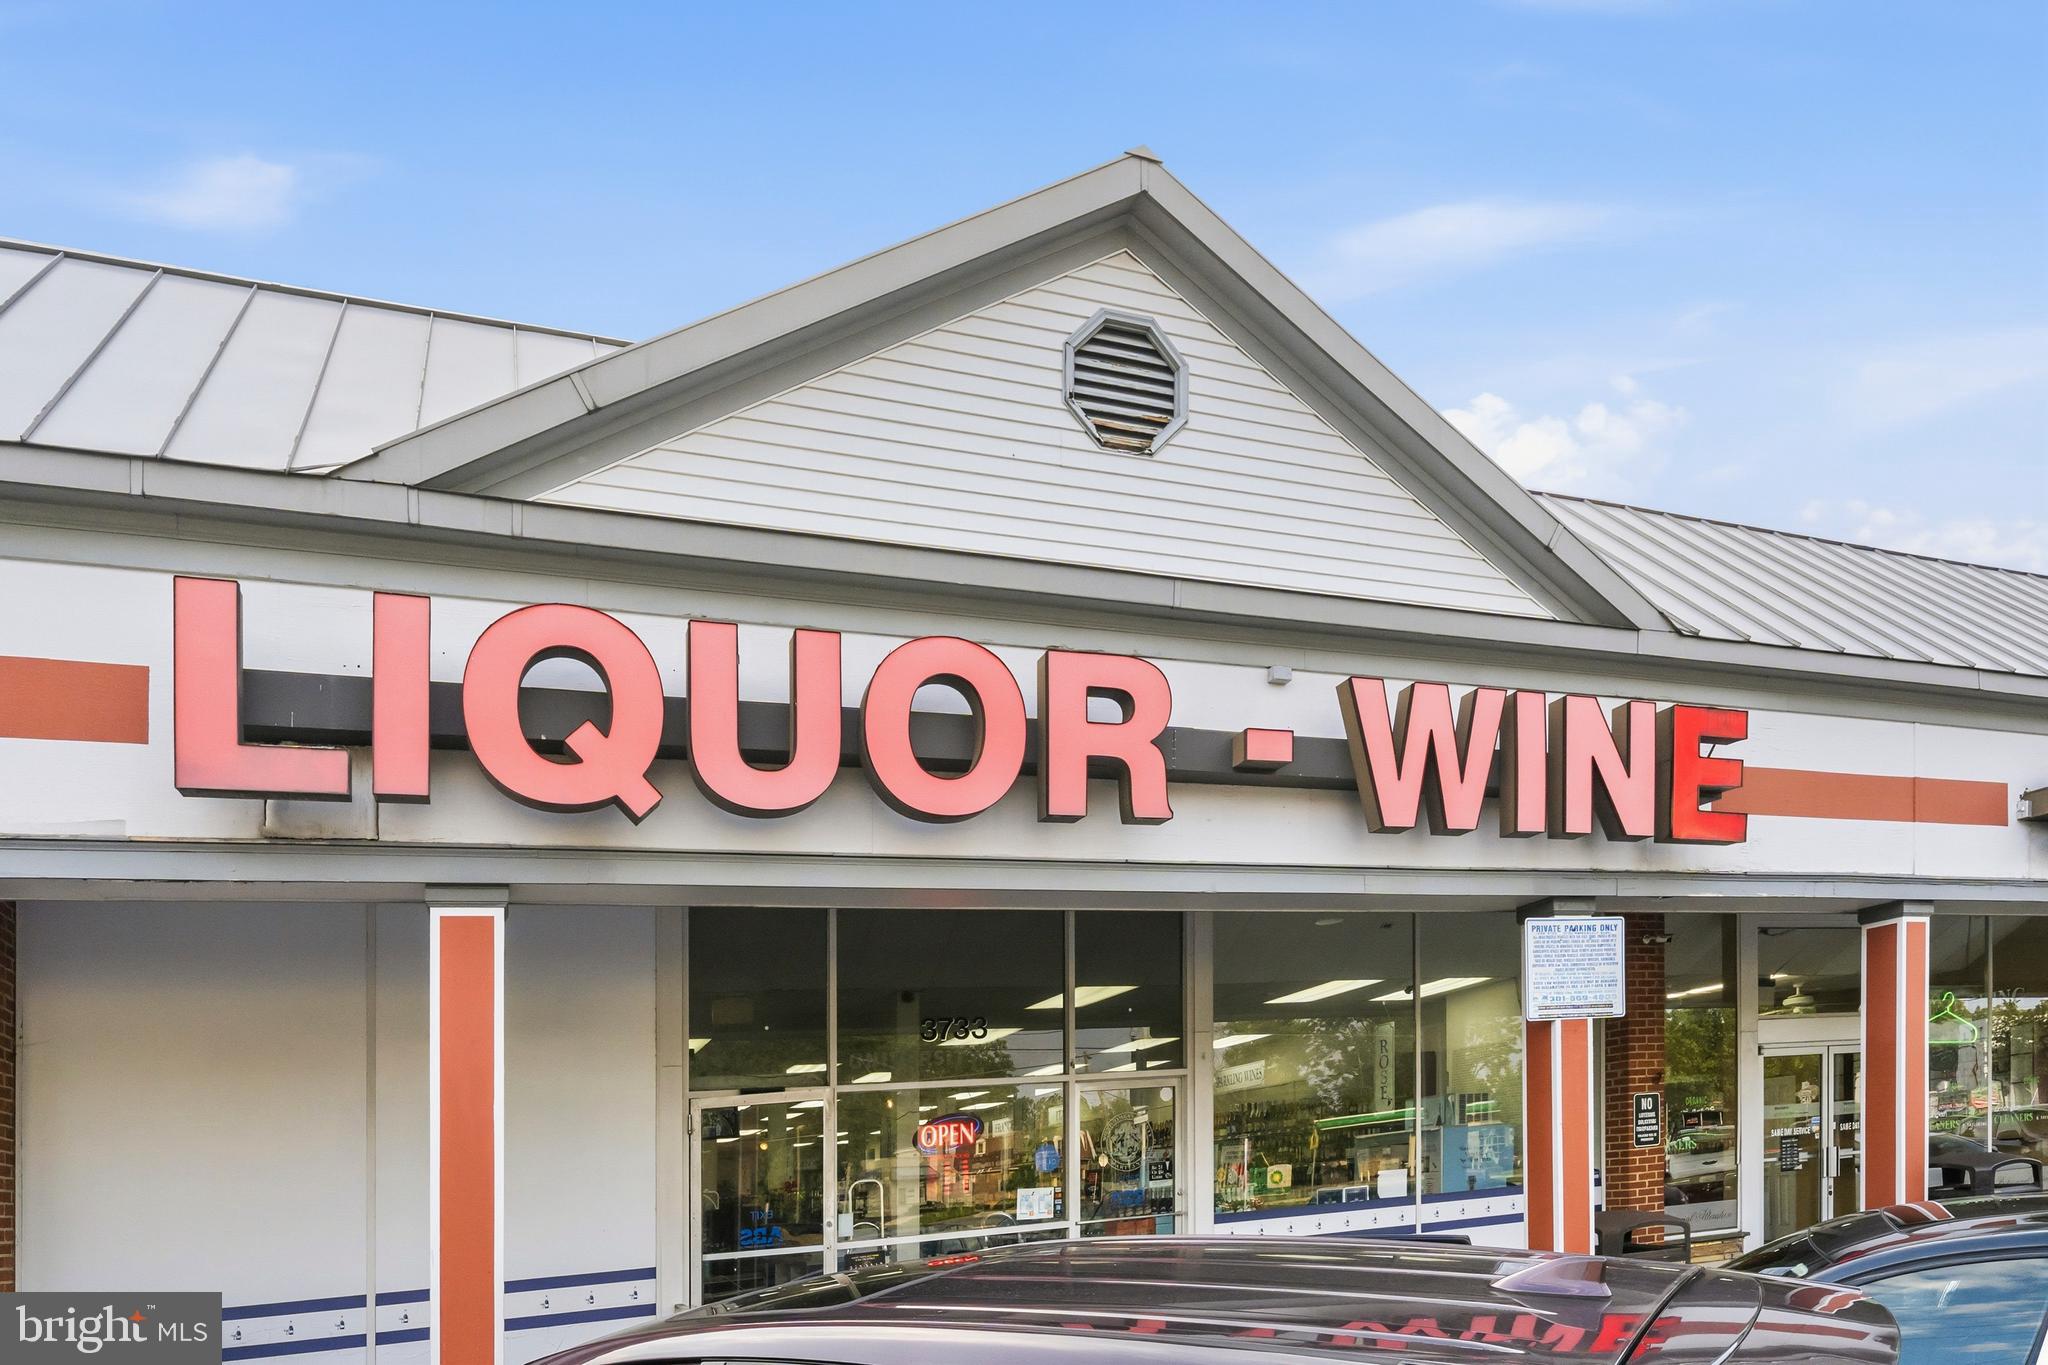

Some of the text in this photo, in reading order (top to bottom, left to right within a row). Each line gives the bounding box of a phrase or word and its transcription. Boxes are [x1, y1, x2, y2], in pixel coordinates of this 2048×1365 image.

[173, 575, 1174, 825] LIQUOR
[1336, 676, 1748, 845] WINE
[1531, 923, 1618, 933] PRIVATE PARKING ONLY
[920, 1016, 988, 1042] 3733
[1641, 1096, 1653, 1110] NO
[920, 1122, 975, 1148] OPEN
